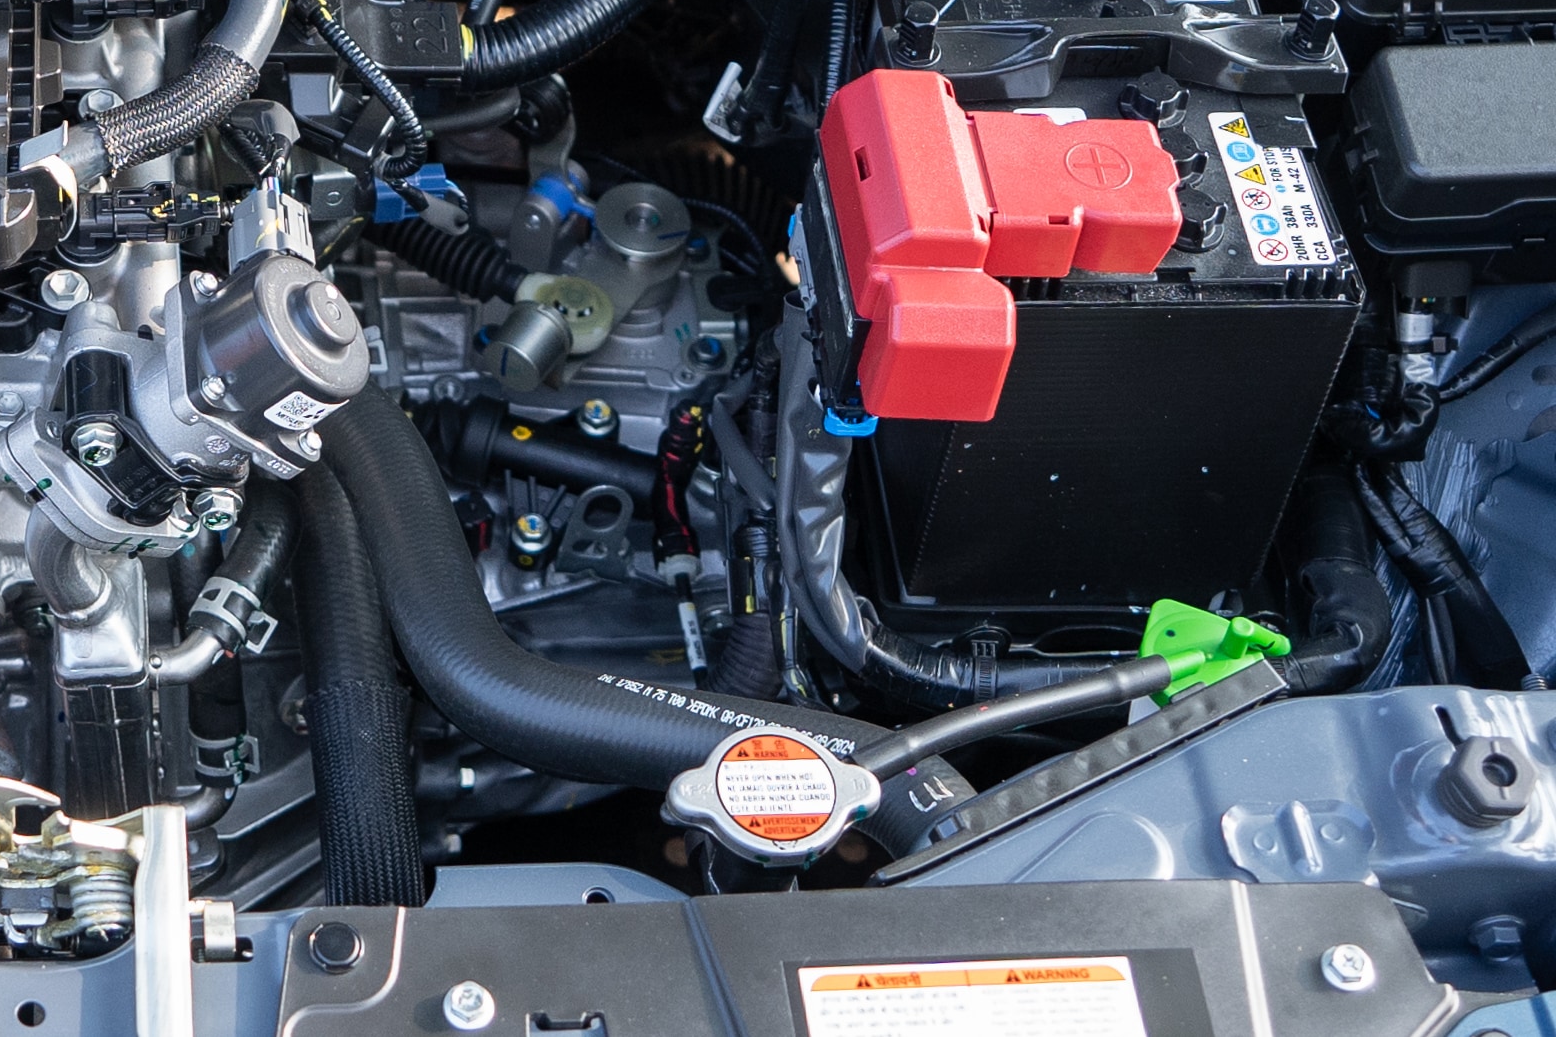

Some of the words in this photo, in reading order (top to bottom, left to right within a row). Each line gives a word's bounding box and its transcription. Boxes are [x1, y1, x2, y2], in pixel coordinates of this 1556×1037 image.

[1287, 167, 1306, 193] M-42
[1300, 204, 1318, 229] 330A
[1292, 235, 1310, 261] 20HR
[1313, 241, 1329, 261] CCA
[753, 750, 789, 759] WARNING
[775, 773, 797, 781] WHEN
[769, 794, 796, 802] NUNCA
[763, 816, 819, 825] AVERTISSEMENT
[764, 826, 807, 834] ADVERTENCIA
[1022, 967, 1091, 981] WARNING
